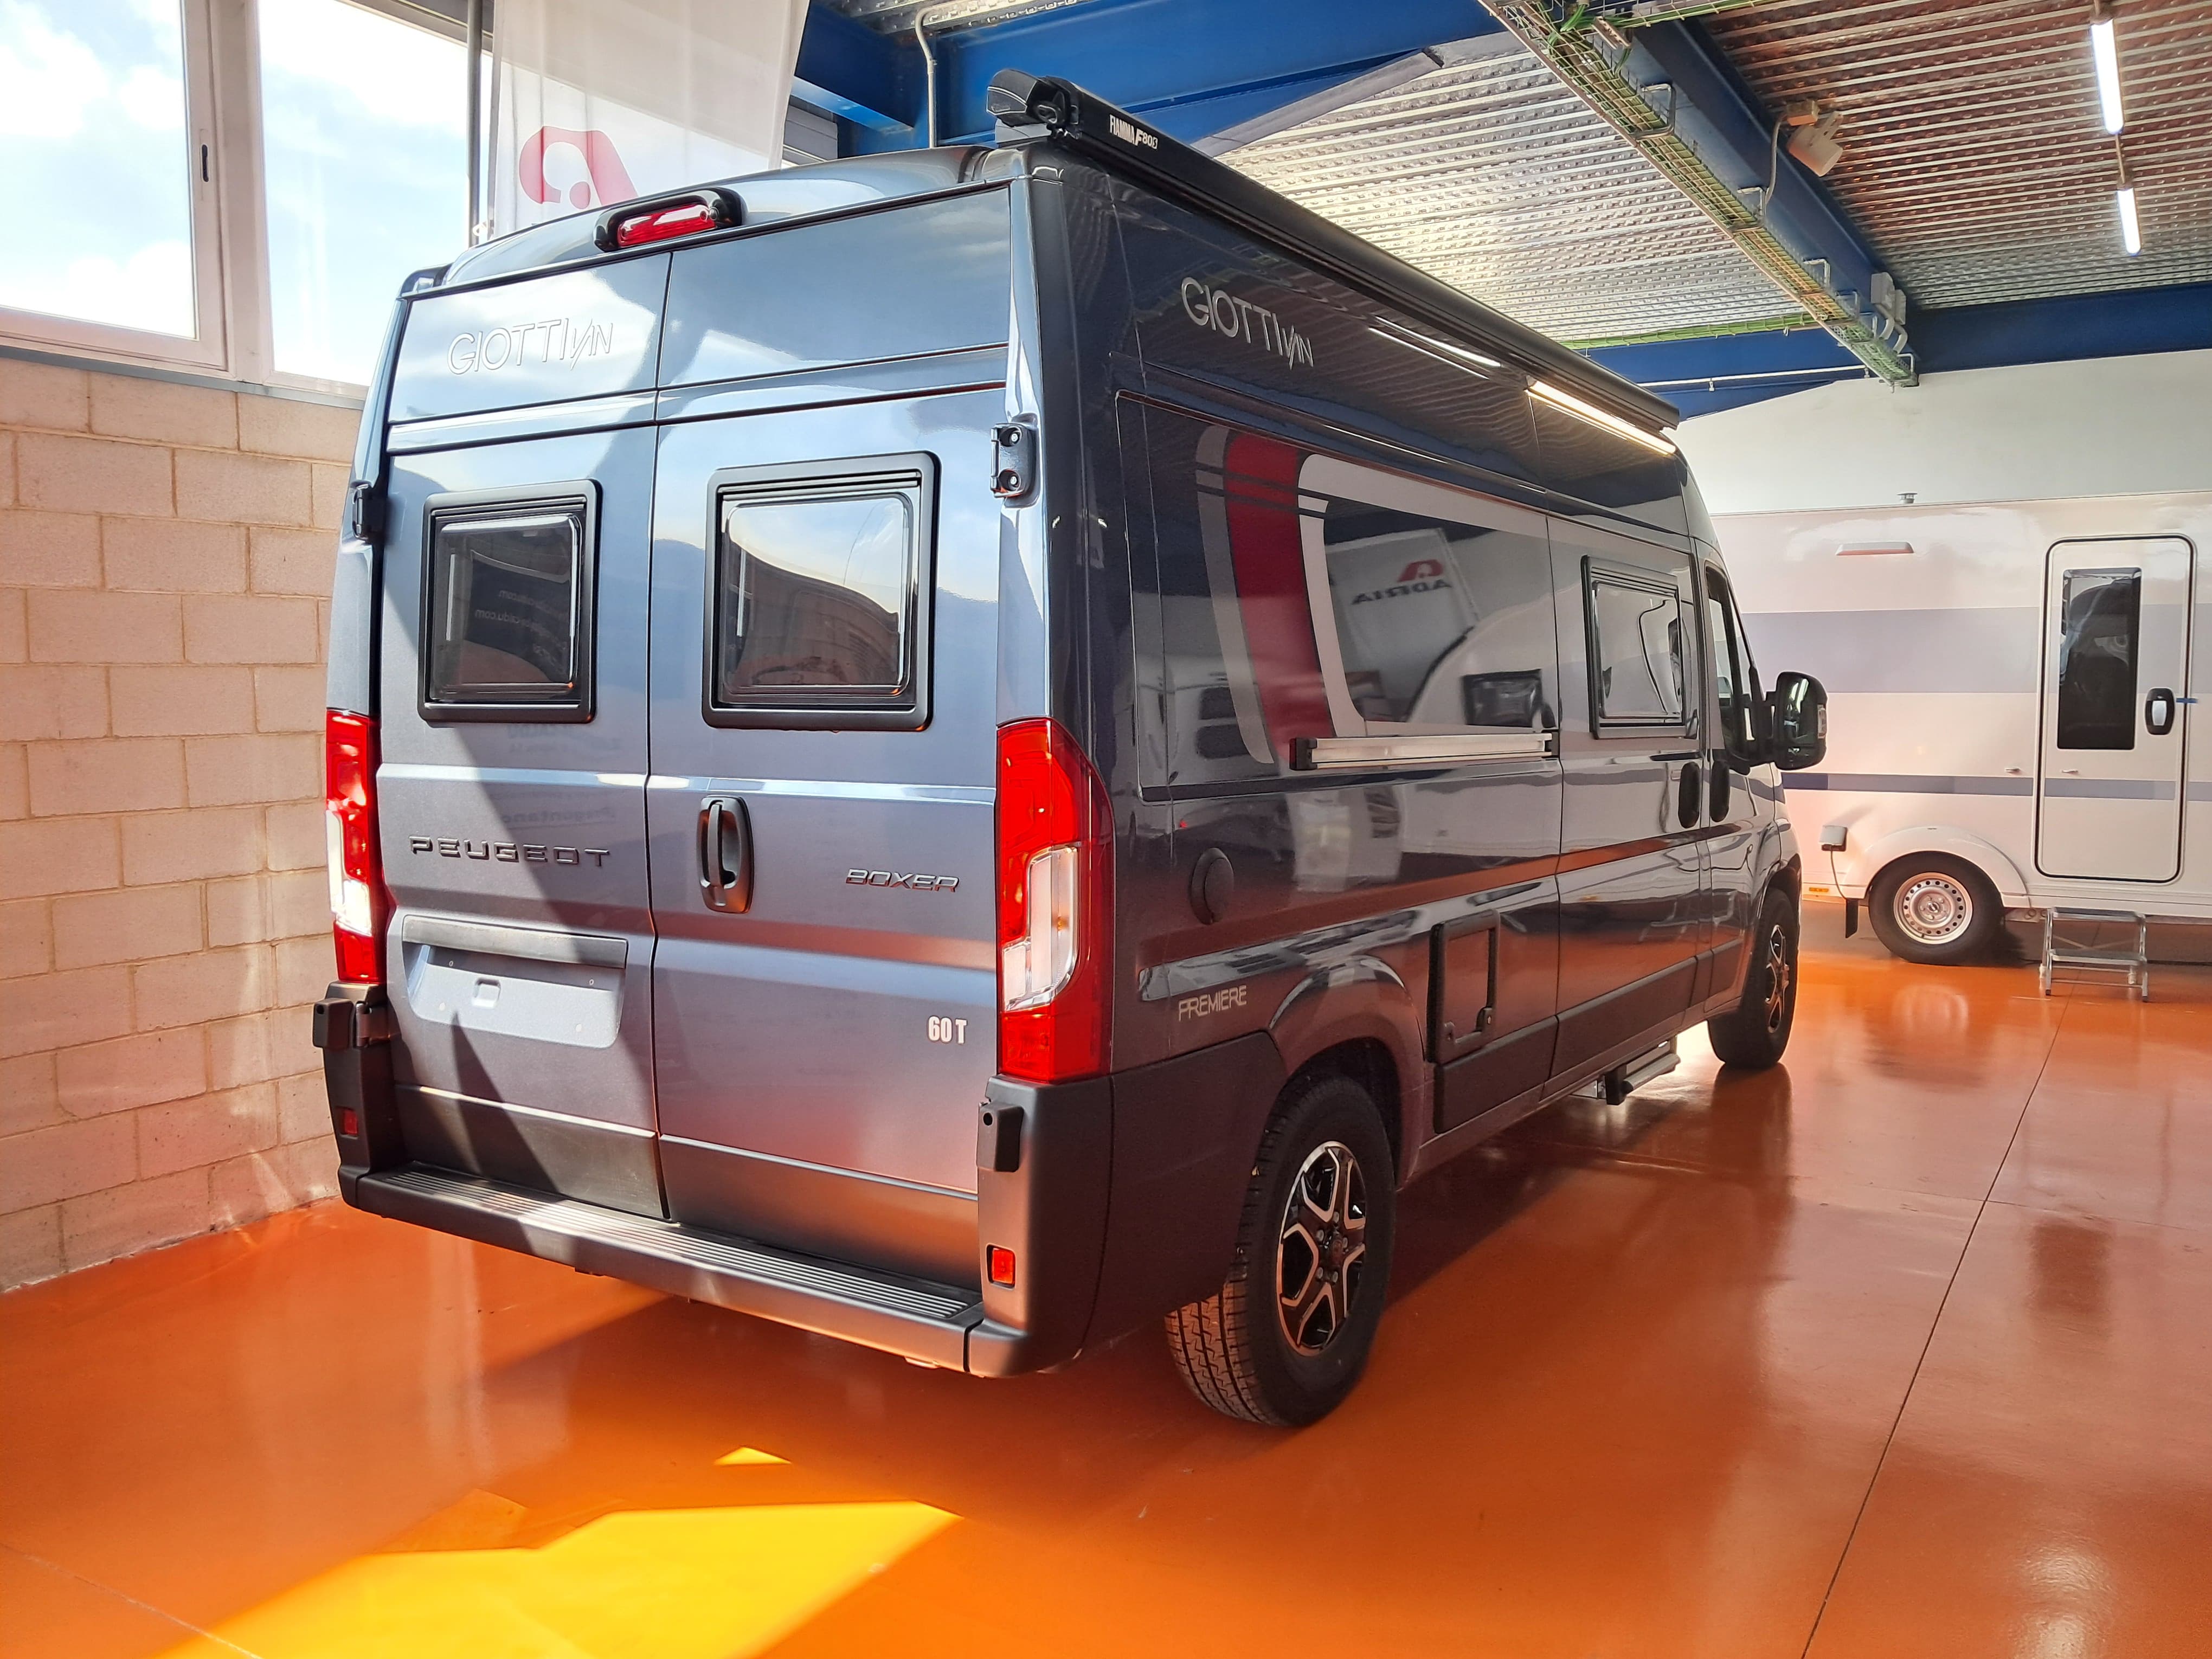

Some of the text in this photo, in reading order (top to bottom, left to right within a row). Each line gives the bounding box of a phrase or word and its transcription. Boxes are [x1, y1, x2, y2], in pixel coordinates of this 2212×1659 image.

[1109, 114, 1135, 144] FIAMMA
[409, 835, 610, 867] PEUGEOT
[845, 868, 960, 893] BOXER
[1179, 985, 1248, 1022] PREMIERE
